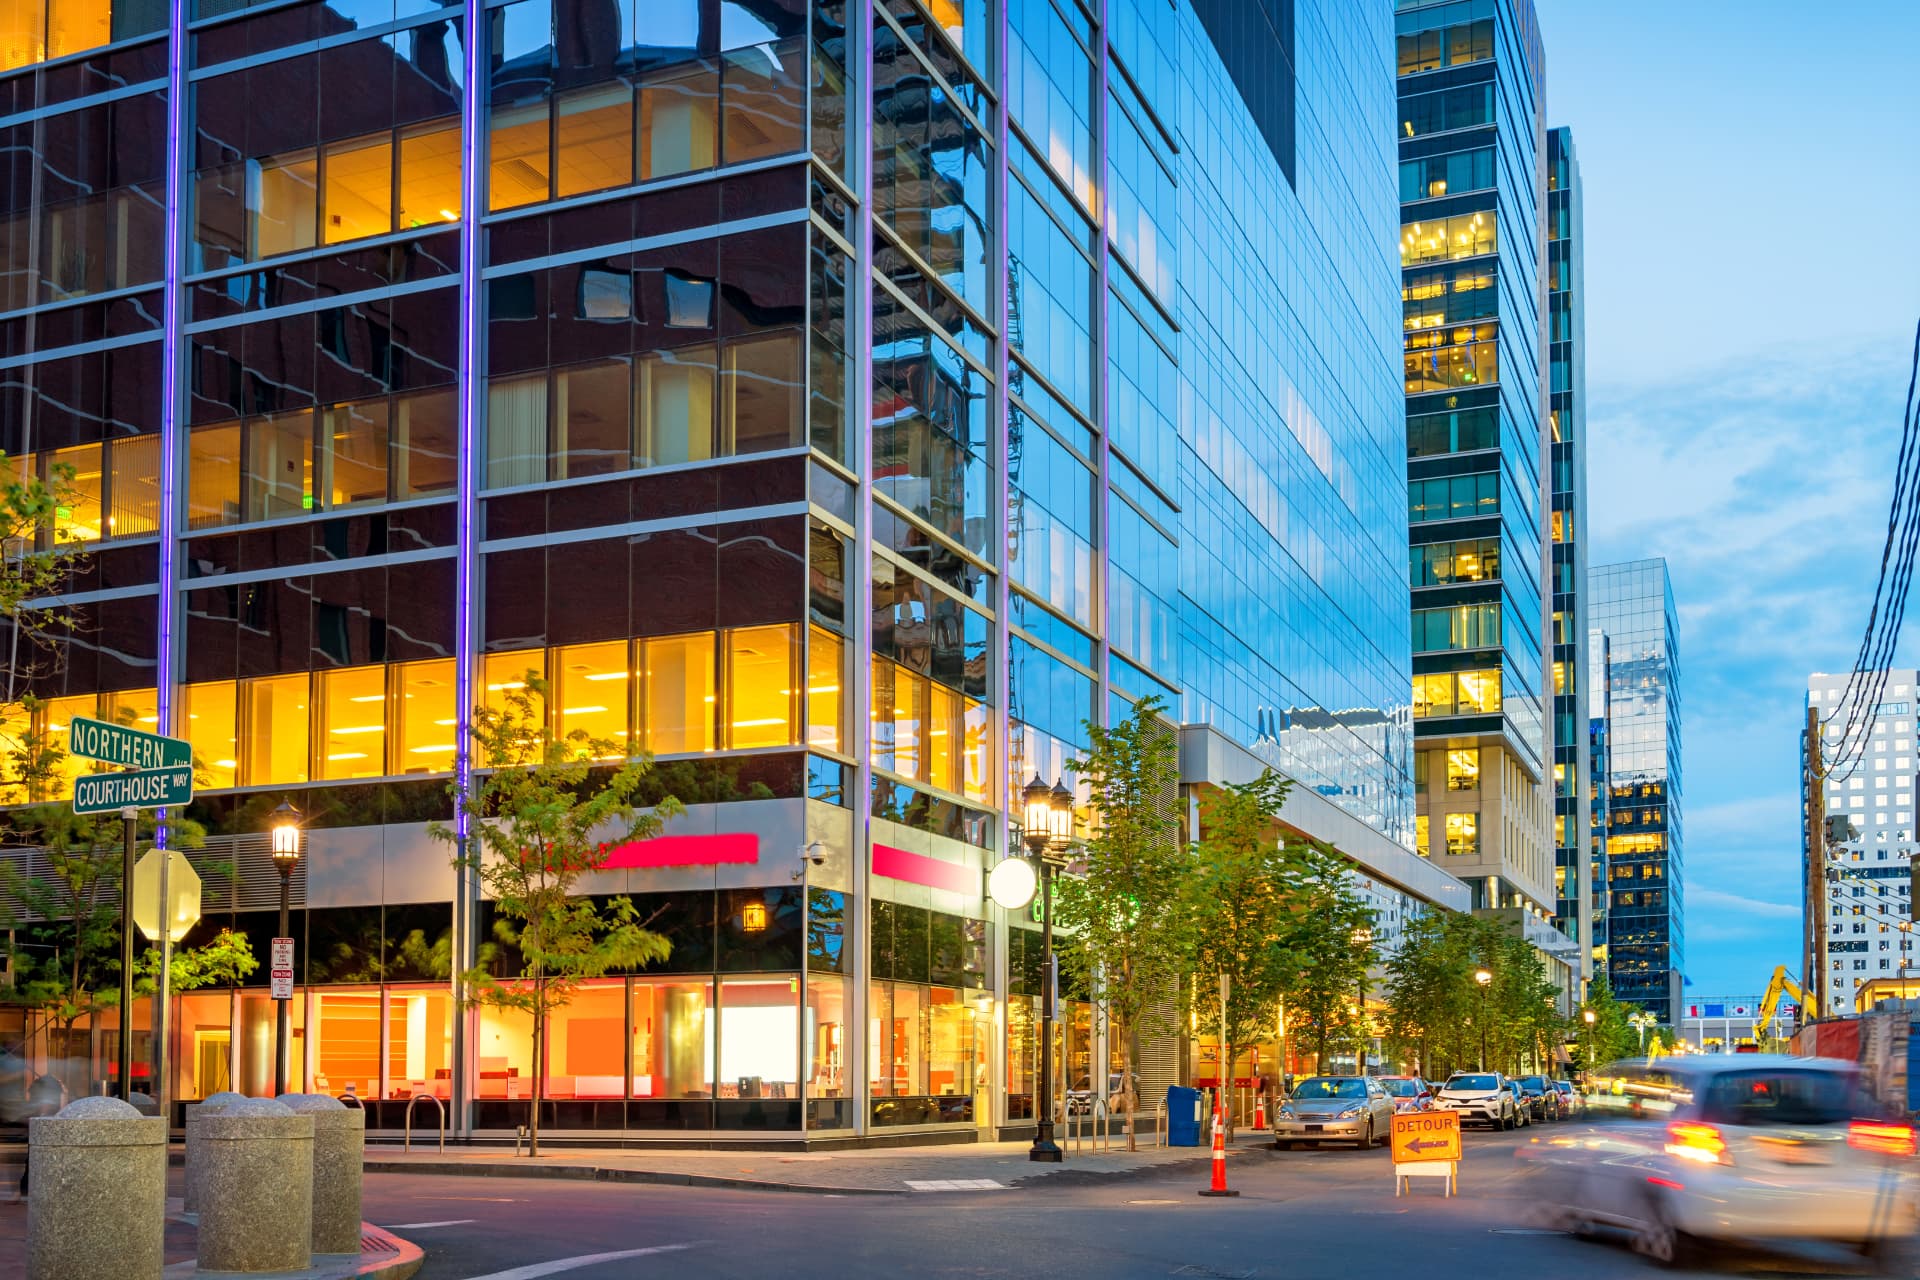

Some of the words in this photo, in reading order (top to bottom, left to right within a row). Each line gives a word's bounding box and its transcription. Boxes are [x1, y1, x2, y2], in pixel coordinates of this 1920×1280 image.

[74, 723, 164, 768] NORTHERN
[78, 775, 170, 806] COURTHOUSE
[173, 773, 188, 787] WAY
[1397, 1118, 1453, 1133] DETOUR
